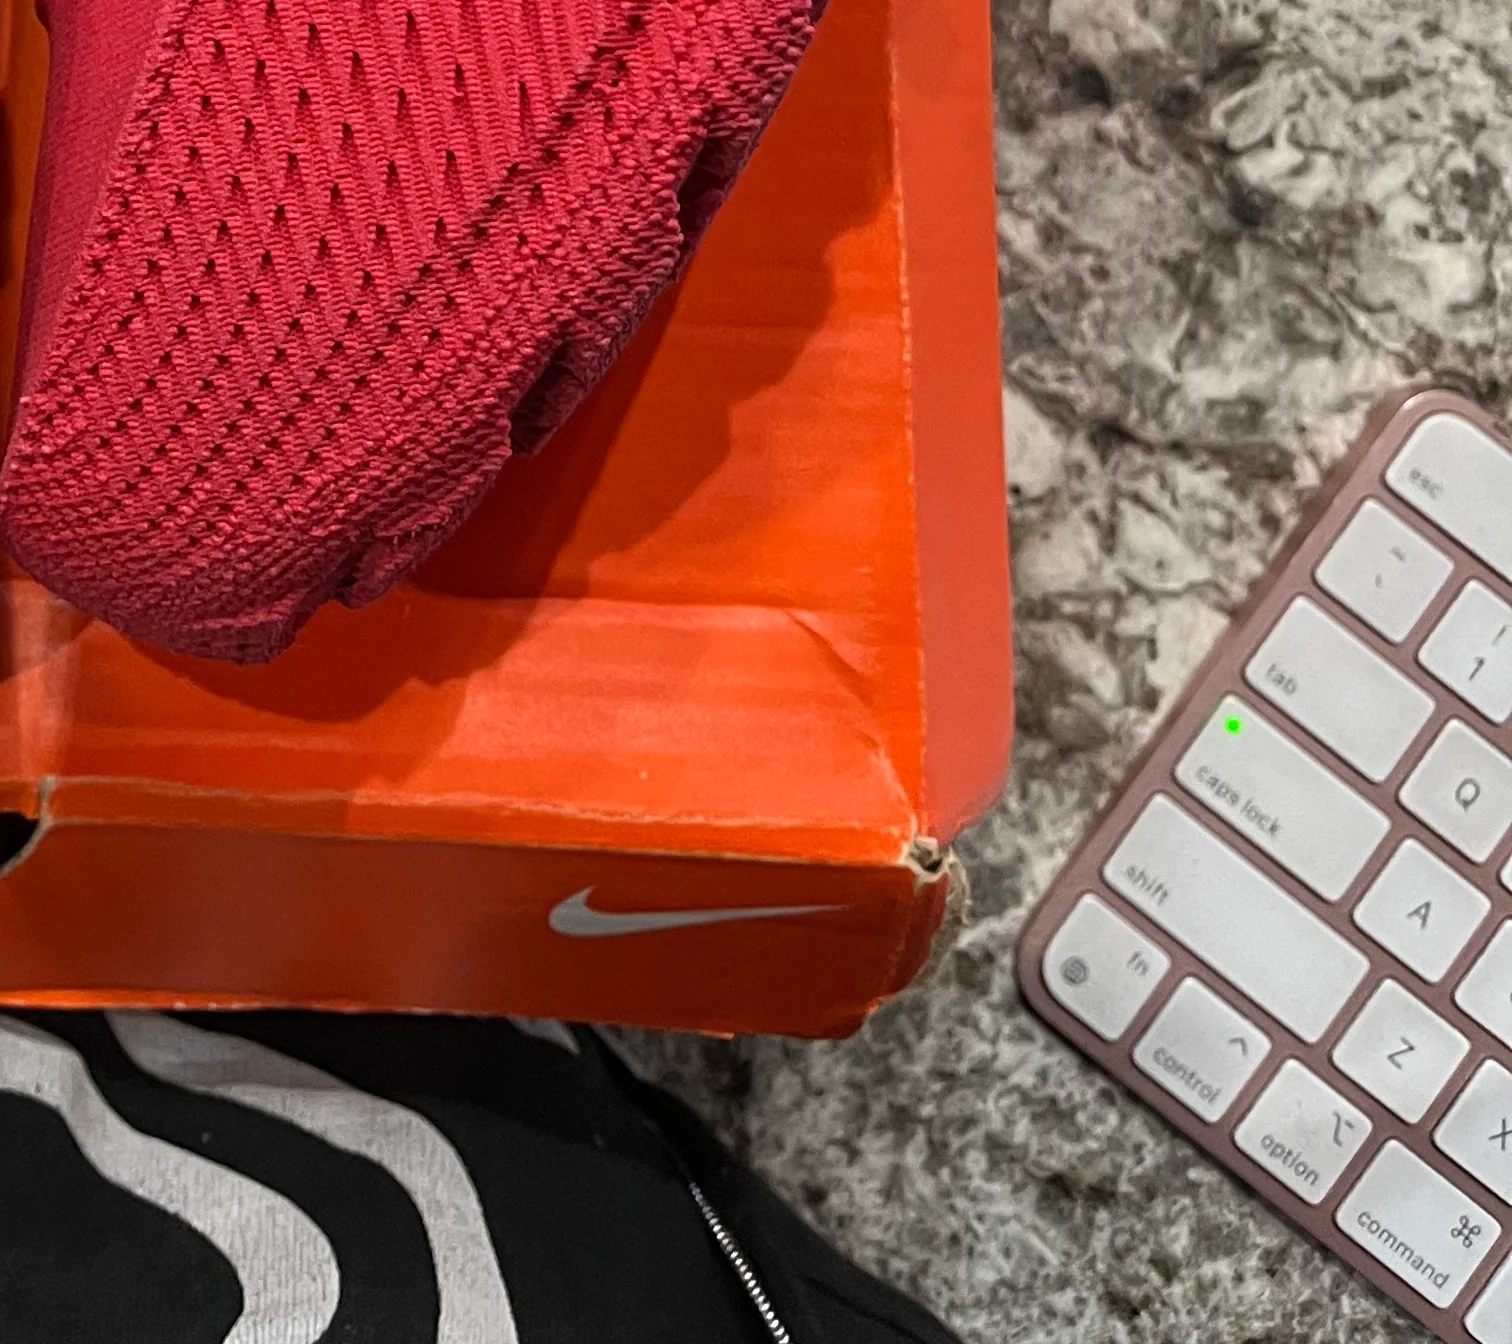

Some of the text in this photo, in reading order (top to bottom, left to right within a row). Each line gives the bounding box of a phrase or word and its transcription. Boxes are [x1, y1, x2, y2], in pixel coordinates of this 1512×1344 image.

[1409, 468, 1442, 500] esc
[1264, 663, 1299, 696] tab
[1468, 656, 1486, 682] 1
[1194, 764, 1283, 838] caps lock
[1454, 777, 1481, 812] Q
[1124, 863, 1170, 907] shift
[1406, 900, 1433, 930] A
[1127, 950, 1150, 977] fn
[1386, 1035, 1416, 1070] Z
[1152, 1046, 1222, 1105] control
[1259, 1132, 1321, 1188] option
[1356, 1210, 1451, 1291] command
